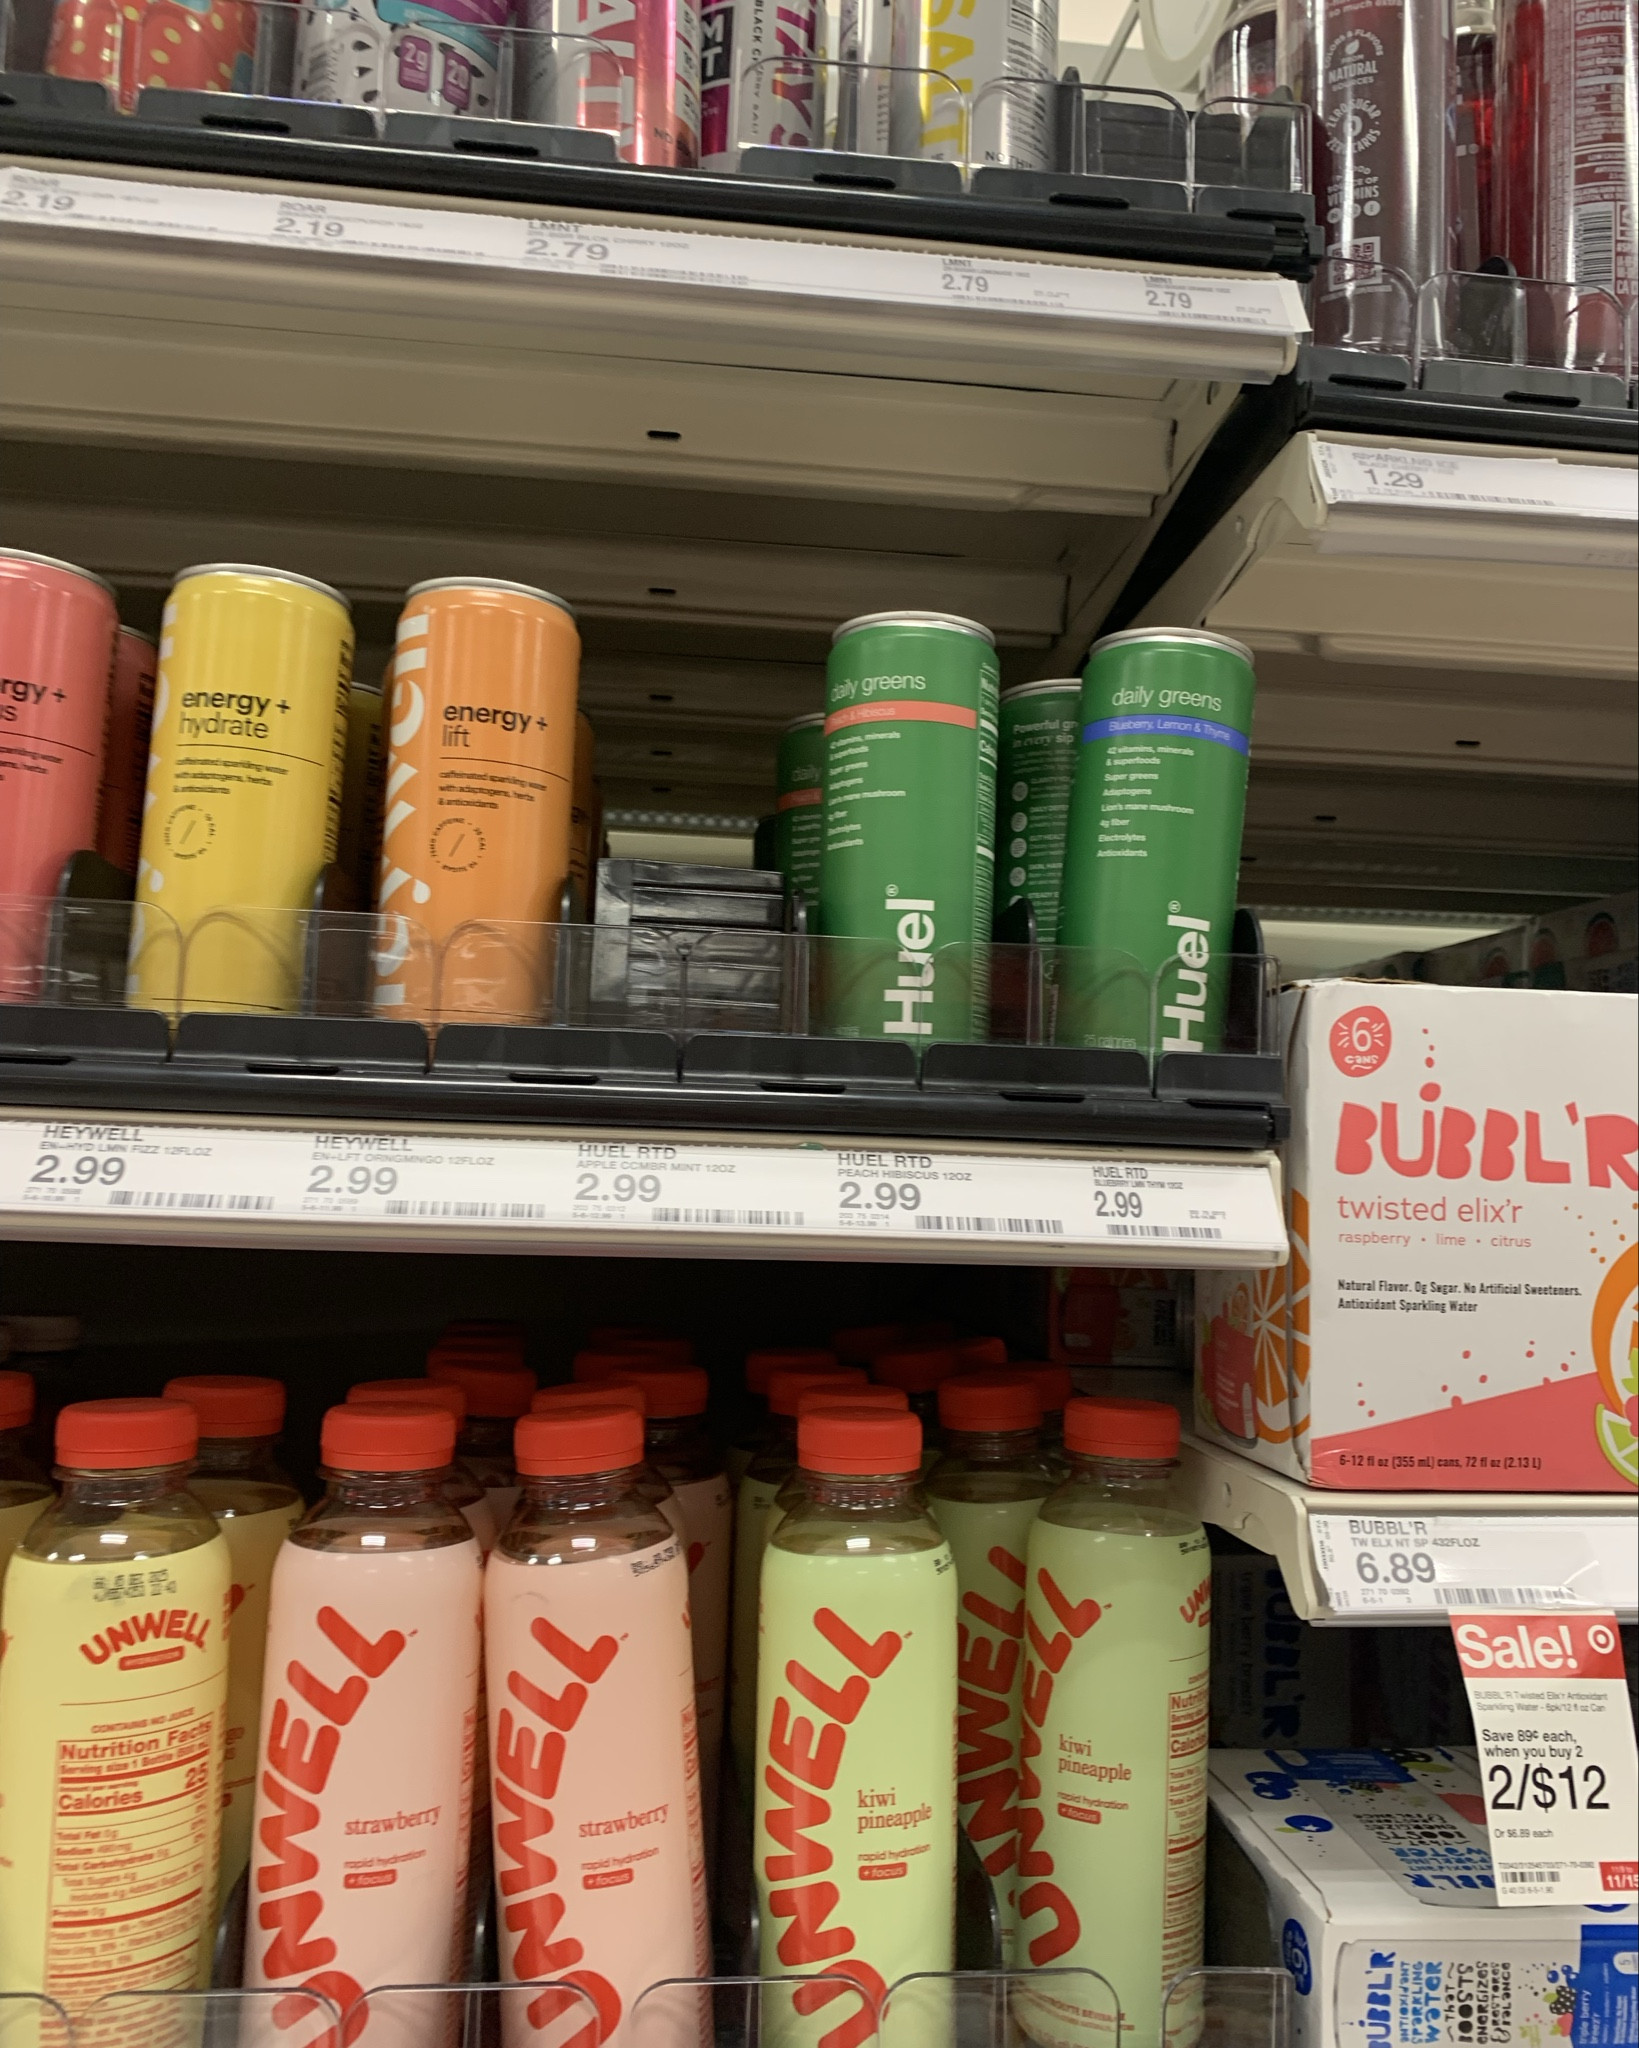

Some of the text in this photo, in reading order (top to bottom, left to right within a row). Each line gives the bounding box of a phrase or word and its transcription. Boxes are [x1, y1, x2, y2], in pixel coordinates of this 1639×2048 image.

[1328, 60, 1378, 84] NATURAL
[274, 216, 345, 237] 2.19
[525, 238, 611, 261] 2.79
[942, 273, 990, 293] 2.79
[1145, 290, 1193, 309] 2.79
[1364, 468, 1424, 489] 1.29
[861, 674, 927, 697] greens
[181, 690, 271, 718] energy
[1111, 685, 1223, 712] daily greens
[179, 711, 270, 739] hydrate
[443, 703, 533, 735] energy
[442, 724, 471, 748] lift
[1113, 756, 1161, 766] superfoods
[1098, 834, 1147, 843] Electrolytes
[883, 898, 936, 1035] Huel
[1162, 913, 1211, 1052] Huel
[1352, 1016, 1373, 1052] 6
[43, 1124, 144, 1142] HEYWELL
[314, 1135, 412, 1151] HEYWELL
[578, 1143, 677, 1160] HUEL RTD
[838, 1152, 933, 1169] HUEL RTD
[30, 1154, 126, 1186] 2.99
[576, 1160, 617, 1170] APPLE
[671, 1163, 702, 1173] MINT
[838, 1168, 880, 1179] PEACH
[882, 1169, 940, 1181] HIBISCUS
[1092, 1166, 1149, 1180] HUEL RTD
[306, 1164, 399, 1195] 2.99
[574, 1172, 662, 1203] 2.99
[838, 1180, 922, 1211] 2.99
[1094, 1190, 1143, 1218] 2.99
[1337, 1195, 1523, 1224] twisted elix'r
[1338, 1231, 1532, 1248] raspberry lime citrus
[1337, 1279, 1582, 1298] Natural Flavor. Sugar. No Artificial Sweeteners.
[1337, 1297, 1478, 1315] Antioxidant Sparkling Water
[1339, 1454, 1365, 1467] 6-12
[1377, 1457, 1389, 1468] oz
[1390, 1454, 1416, 1470] (355
[1437, 1456, 1463, 1470] cans,
[1465, 1455, 1479, 1468] 72
[1490, 1458, 1502, 1469] oz
[1503, 1455, 1529, 1471] (2.13
[1349, 1519, 1428, 1536] BUBBL'R
[1351, 1537, 1368, 1547] TW
[1371, 1537, 1394, 1548] ELX
[1395, 1538, 1411, 1548] NT
[1414, 1538, 1429, 1549] SP
[1356, 1551, 1436, 1584] 6.89
[80, 1609, 211, 1665] UNWELL
[1457, 1624, 1579, 1670] Sale!
[1514, 1691, 1546, 1700] Twisted
[1567, 1692, 1609, 1701] Antioxidant
[1476, 1702, 1515, 1713] Sparkling
[1516, 1703, 1539, 1712] Water
[60, 1720, 212, 1760] Nutrition Facts
[1058, 1734, 1093, 1757] kiwi
[1482, 1728, 1577, 1744] Save 89¢ each,
[1484, 1745, 1584, 1760] when you buy 2
[1057, 1756, 1133, 1784] pineapple
[58, 1761, 208, 1810] Calories 25
[1488, 1763, 1610, 1813] 2/$12
[857, 1787, 897, 1809] kiwi
[1057, 1790, 1130, 1811] rapid hydration
[257, 1604, 408, 2048] UNWELL
[344, 1805, 442, 1836] strawberry
[578, 1803, 670, 1838] strawberry
[764, 1606, 903, 2048] UNWELL
[857, 1802, 933, 1834] pineapple
[1067, 1809, 1099, 1824] focus
[494, 1615, 623, 2048] UNWELL
[1532, 1828, 1554, 1838] each
[376, 1849, 428, 1868] hydration
[611, 1846, 661, 1868] hydration
[858, 1843, 932, 1863] rapid hydration
[872, 1866, 906, 1879] focus
[1606, 1874, 1639, 1889] 11/15
